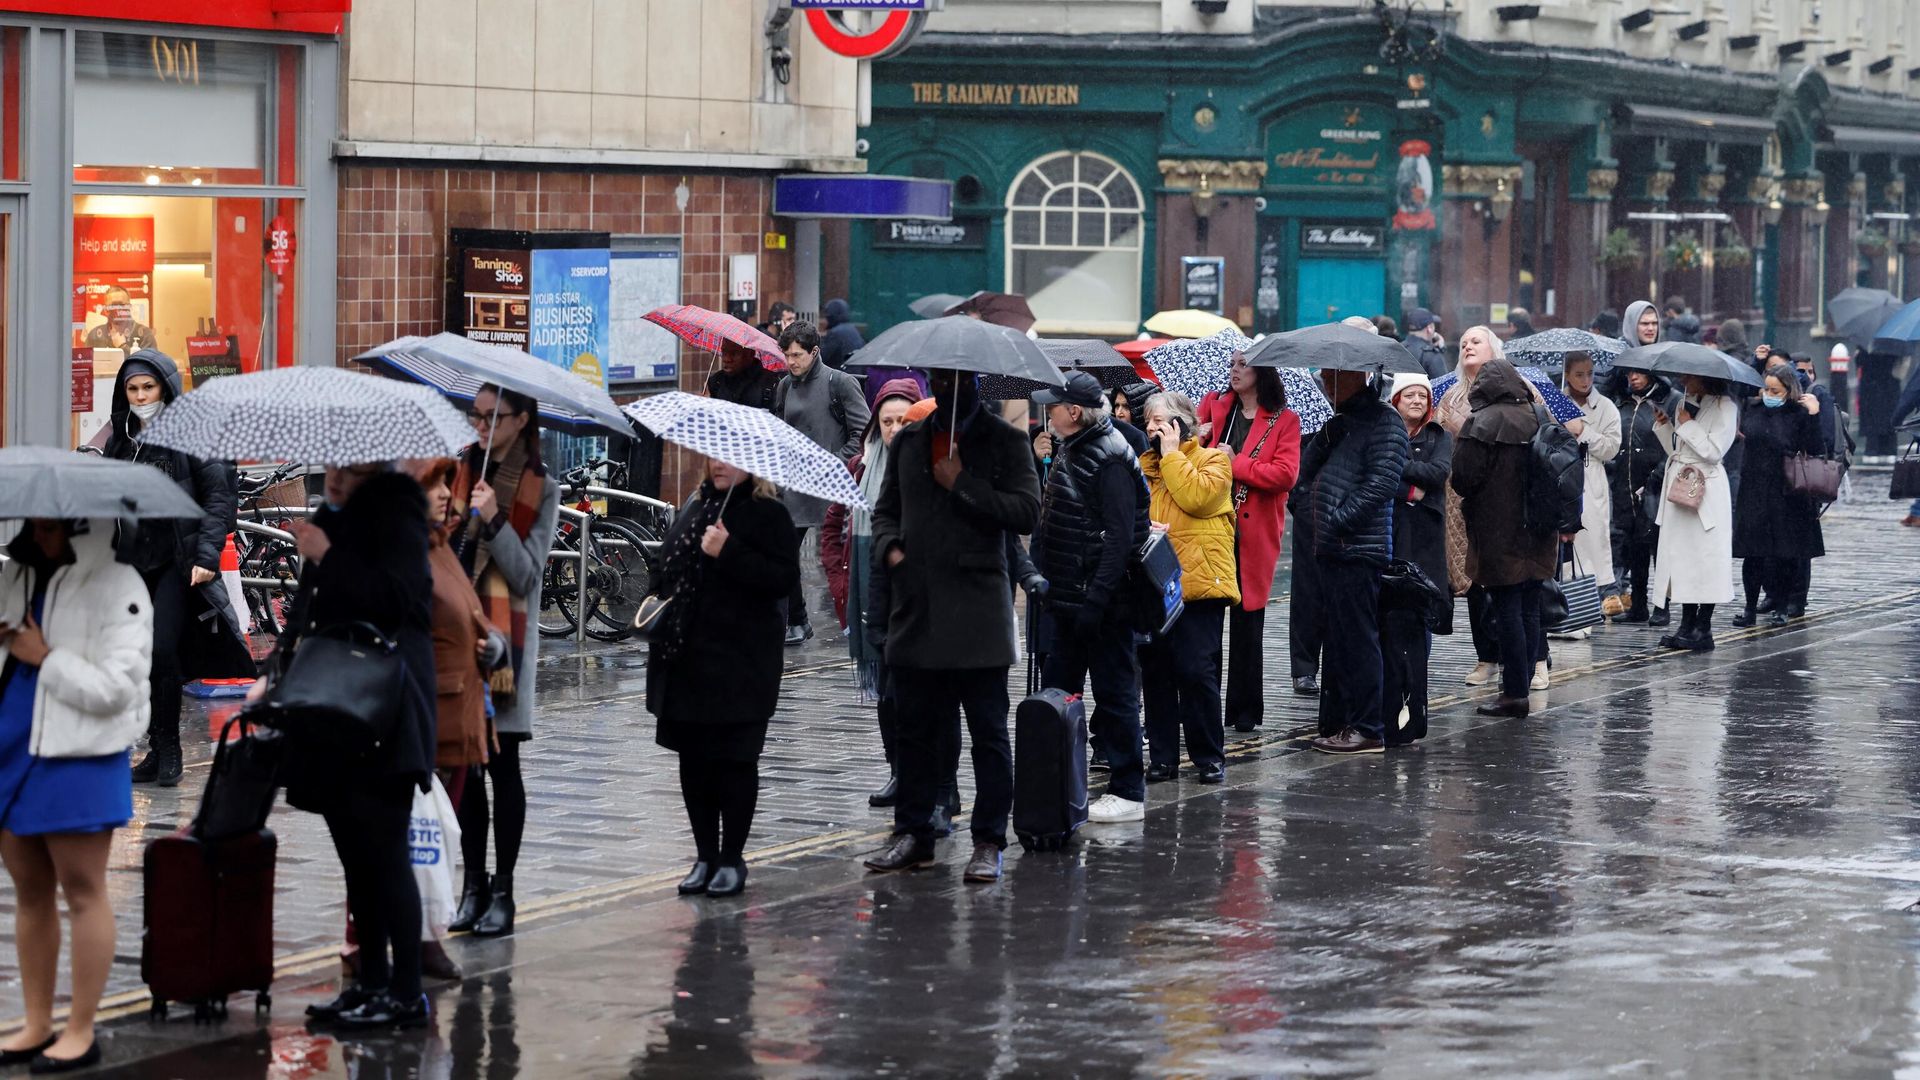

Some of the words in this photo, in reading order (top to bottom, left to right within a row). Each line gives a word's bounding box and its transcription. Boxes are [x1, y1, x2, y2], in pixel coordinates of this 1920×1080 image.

[911, 82, 942, 103] THE
[947, 83, 1014, 105] RAILWAY
[1017, 84, 1079, 105] TAVERN
[80, 238, 100, 255] Help
[102, 239, 118, 252] and
[121, 239, 147, 252] advice
[271, 230, 288, 250] 5G
[472, 256, 512, 273] Tanning
[495, 269, 523, 285] Shop
[534, 293, 554, 305] YOUR
[555, 292, 580, 304] 5-STAR
[534, 306, 593, 326] BUSINESS
[467, 330, 490, 341] INSIDE
[490, 331, 526, 343] LIVERPOOL
[533, 326, 589, 347] ADDRESS
